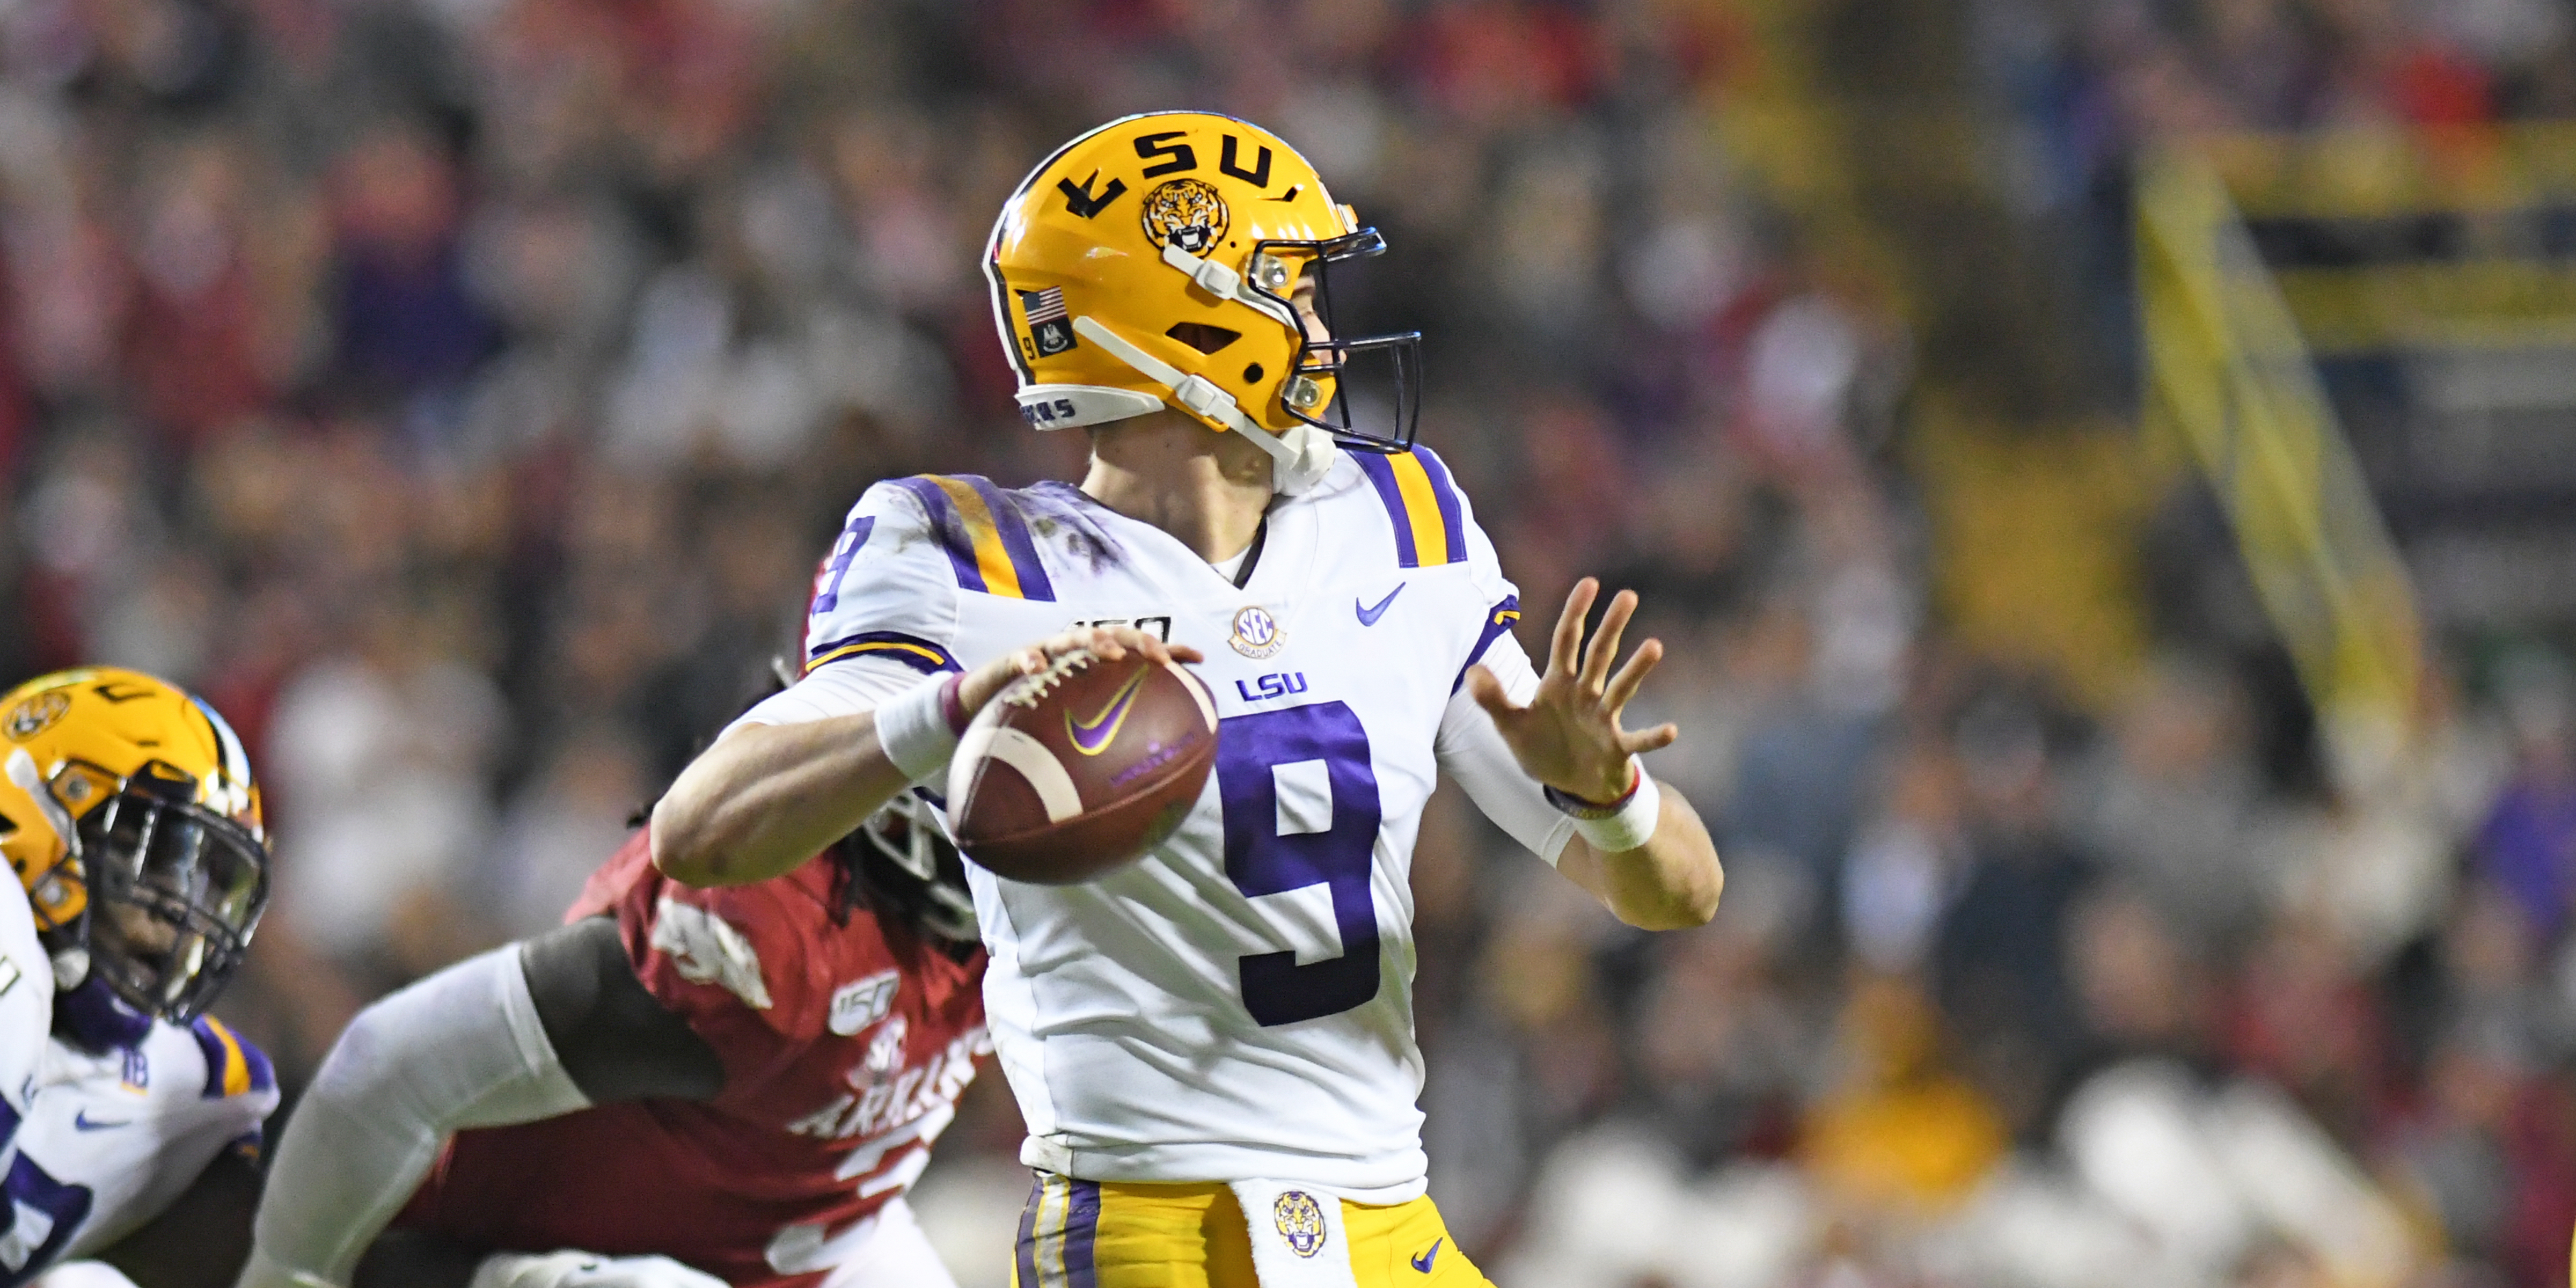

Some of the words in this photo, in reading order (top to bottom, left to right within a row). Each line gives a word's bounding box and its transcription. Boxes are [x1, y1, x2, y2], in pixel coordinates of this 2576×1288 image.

[1057, 131, 1271, 219] LSU
[1023, 336, 1035, 360] 9
[1238, 608, 1274, 645] SEC
[1239, 640, 1282, 657] GRADUATE
[1235, 672, 1308, 701] LSU
[1217, 700, 1381, 1027] 9
